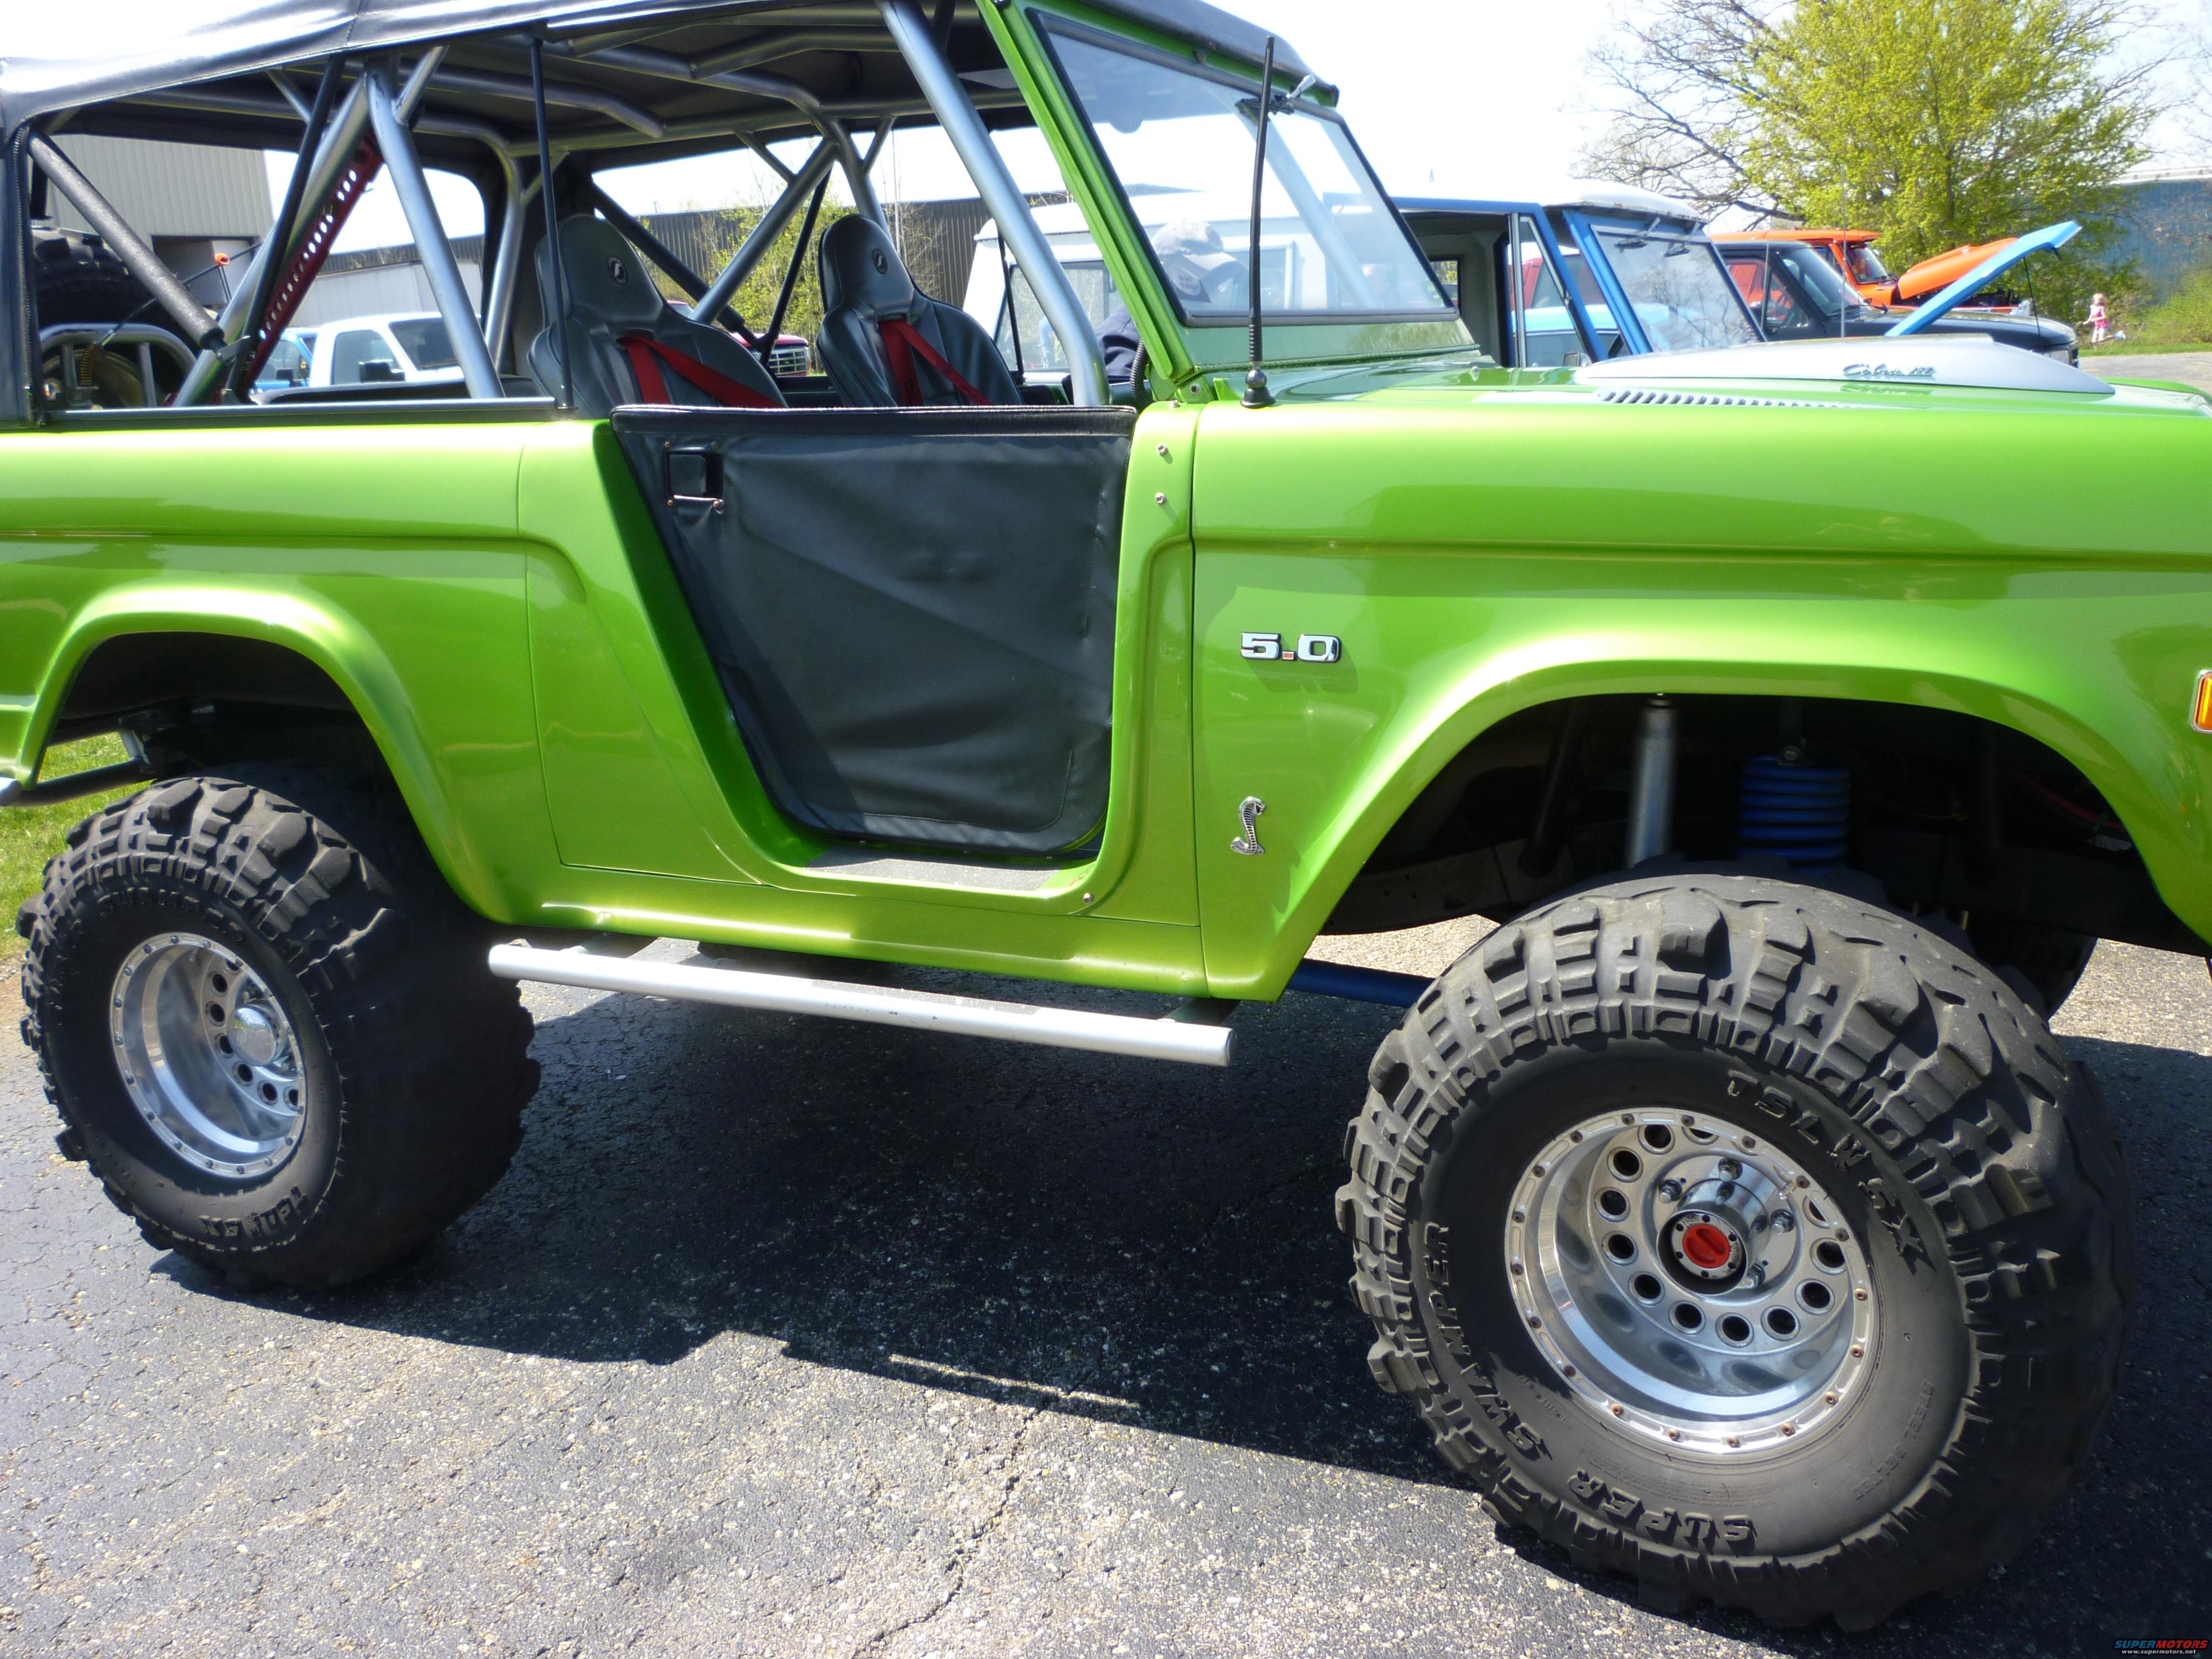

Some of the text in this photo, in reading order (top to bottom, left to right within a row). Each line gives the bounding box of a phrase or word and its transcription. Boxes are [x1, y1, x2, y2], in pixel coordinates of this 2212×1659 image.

[1241, 632, 1342, 662] 5.0
[1728, 1068, 1820, 1145] TSL
[1423, 1222, 1542, 1451] SWAMPER
[1567, 1468, 1751, 1541] SUPER
